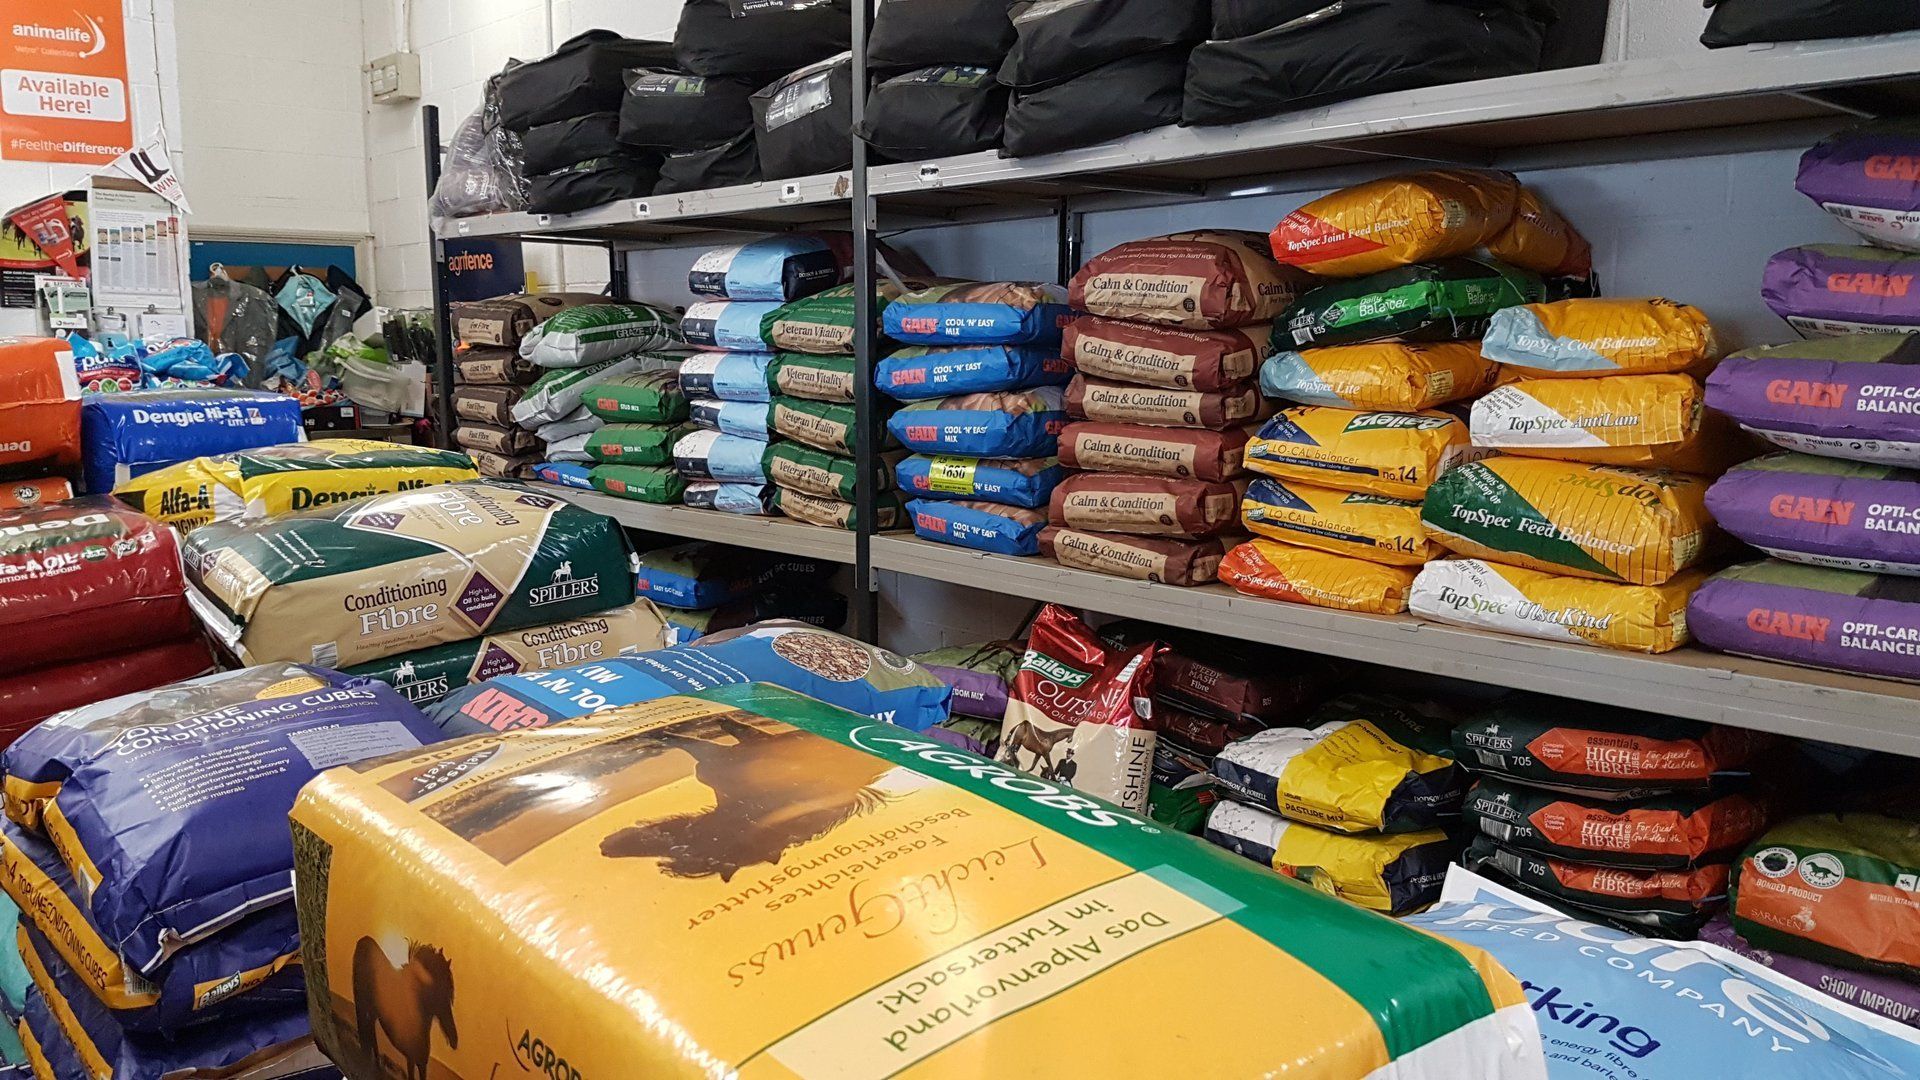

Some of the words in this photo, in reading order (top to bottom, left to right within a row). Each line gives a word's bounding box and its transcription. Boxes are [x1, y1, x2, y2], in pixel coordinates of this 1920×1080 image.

[12, 24, 90, 42] animalife
[18, 77, 109, 98] Available
[40, 96, 91, 114] Here!
[11, 139, 125, 156] #FeeltheDifference
[154, 175, 178, 195] WIN
[1288, 237, 1321, 251] TopSpec
[1322, 234, 1345, 246] Joint
[1348, 226, 1371, 239] Feed
[448, 251, 494, 276] agrifence
[1093, 278, 1121, 290] Calm
[1123, 278, 1133, 289] &
[1135, 278, 1188, 294] Condition
[1827, 273, 1914, 297] GAIN
[1360, 300, 1408, 317] Balancer
[782, 324, 812, 336] Veteran
[814, 326, 845, 340] Vitality
[901, 318, 938, 334] GAIN
[945, 318, 964, 328] COOL
[978, 318, 994, 328] EASY
[946, 328, 960, 336] MIX
[1516, 334, 1564, 352] TopSpec
[1568, 338, 1599, 352] Cool
[1602, 334, 1660, 349] Balancer
[1083, 340, 1112, 358] Calm
[1114, 349, 1124, 360] &
[1125, 352, 1180, 371] Condition
[786, 368, 816, 381] Veteran
[816, 372, 843, 388] Vitality
[891, 368, 927, 386] GAIN
[933, 364, 952, 374] COOL
[965, 362, 982, 372] EASY
[934, 374, 948, 383] MIX
[1296, 380, 1332, 392] TopSpec
[1336, 382, 1361, 394] Lite
[1766, 379, 1848, 408] GAIN
[1091, 390, 1118, 403] Calm
[1120, 393, 1129, 404] &
[1131, 392, 1186, 408] Condition
[133, 409, 205, 427] Dengie
[205, 407, 242, 419] Hi-Fi
[228, 418, 246, 426] LITE
[1353, 413, 1452, 430] Baileys
[1508, 416, 1568, 434] TopSpec
[1571, 412, 1641, 428] AntiLam
[906, 426, 938, 442] GAIN
[944, 426, 962, 434] COOL
[944, 434, 958, 443] MIX
[1083, 439, 1111, 453] Calm
[1113, 444, 1122, 454] &
[1124, 444, 1180, 460] Condition
[1272, 444, 1312, 458] LO-CAL
[1314, 449, 1359, 464] balancer
[1382, 466, 1418, 484] no.14
[20, 488, 33, 498] 20
[984, 484, 1001, 492] EASY
[1560, 472, 1662, 506] TopSpec
[160, 484, 210, 516] Alfa-A
[1071, 494, 1098, 506] Calm
[1100, 496, 1108, 507] &
[1110, 497, 1164, 510] Condition
[1770, 494, 1855, 526] GAIN
[917, 512, 946, 534] GAIN
[952, 522, 970, 532] COOL
[982, 529, 998, 538] EASY
[1270, 508, 1308, 524] LO-CAL
[1312, 516, 1356, 534] balancer
[1451, 504, 1510, 528] TopSpec
[1517, 518, 1555, 538] Feed
[1559, 526, 1636, 556] Balancer
[953, 531, 966, 540] MIX
[1379, 536, 1415, 554] no.14
[1062, 535, 1088, 552] Calm
[1090, 543, 1099, 554] &
[1101, 546, 1152, 568] Condition
[344, 578, 448, 612] Conditioning
[468, 588, 482, 597] High
[530, 576, 599, 605] SPILLERS
[1266, 578, 1289, 591] Joint
[1291, 580, 1313, 596] Feed
[1315, 588, 1364, 604] Balancer
[466, 601, 494, 612] condition
[1440, 586, 1508, 616] TopSpec
[1514, 600, 1612, 630] UlsaKind
[360, 603, 438, 636] Fibre
[1747, 608, 1832, 642] GAIN
[521, 618, 609, 648] Conditioning
[1568, 626, 1599, 640] Cubes
[538, 639, 603, 670] Fibre
[576, 666, 623, 684] MIX
[1022, 651, 1087, 684] Baileys
[1188, 670, 1216, 686] MASH
[972, 690, 984, 701] MIX
[1190, 680, 1210, 692] Fibre
[230, 710, 315, 734] OUTSTANDING
[316, 700, 379, 714] CONDITION
[460, 688, 549, 732] GAIN
[1028, 692, 1050, 710] HIGH
[1052, 709, 1066, 720] OIL
[109, 722, 168, 750] TOP
[174, 706, 246, 732] LINE
[116, 700, 298, 756] CONDITIONING
[300, 689, 376, 708] CUBES
[1465, 732, 1513, 750] SPILLERS
[1511, 756, 1532, 767] 705
[1586, 746, 1632, 764] HIGH
[146, 756, 200, 778] Concentrated
[150, 764, 194, 784] Barley-free
[203, 750, 250, 764] non-heating
[154, 778, 176, 790] Build
[176, 768, 206, 781] muscle
[206, 758, 237, 770] without
[237, 746, 288, 761] supplements
[158, 782, 187, 796] Supply
[188, 766, 235, 784] controllable
[235, 758, 262, 771] energy
[418, 750, 492, 796] Melasse-
[1586, 760, 1633, 775] FIBRE
[163, 784, 196, 801] Support
[197, 771, 248, 789] performance
[256, 758, 290, 770] recovery
[167, 796, 187, 807] Fully
[188, 784, 226, 798] balanced
[245, 768, 278, 782] vitamins
[871, 737, 1147, 830] AGROBS
[210, 785, 246, 799] minerals
[1286, 802, 1326, 820] PASTURE
[1326, 814, 1344, 824] MIX
[1514, 826, 1532, 838] 705
[1582, 821, 1624, 836] HIGH
[1581, 834, 1624, 848] FIBRE
[686, 806, 972, 930] Beschäftigungsfutter
[765, 833, 948, 916] Faserleichtes
[1528, 862, 1546, 876] 705
[1592, 880, 1635, 894] FIBRE
[1756, 878, 1786, 893] BONDED
[1787, 886, 1824, 902] PRODUCT
[1065, 898, 1116, 922] im
[1751, 908, 1801, 930] SARACEN
[1106, 909, 1170, 942] Das
[876, 918, 1056, 1014] Futtersack!
[200, 972, 240, 1006] Baileys
[884, 935, 1102, 1052] Alpenvorland
[1464, 921, 1561, 942] FEED
[1578, 946, 1794, 1054] COMPANY
[1819, 974, 1858, 1000] SHOW
[1550, 1036, 1602, 1059] energy
[1604, 1048, 1638, 1078] fibre
